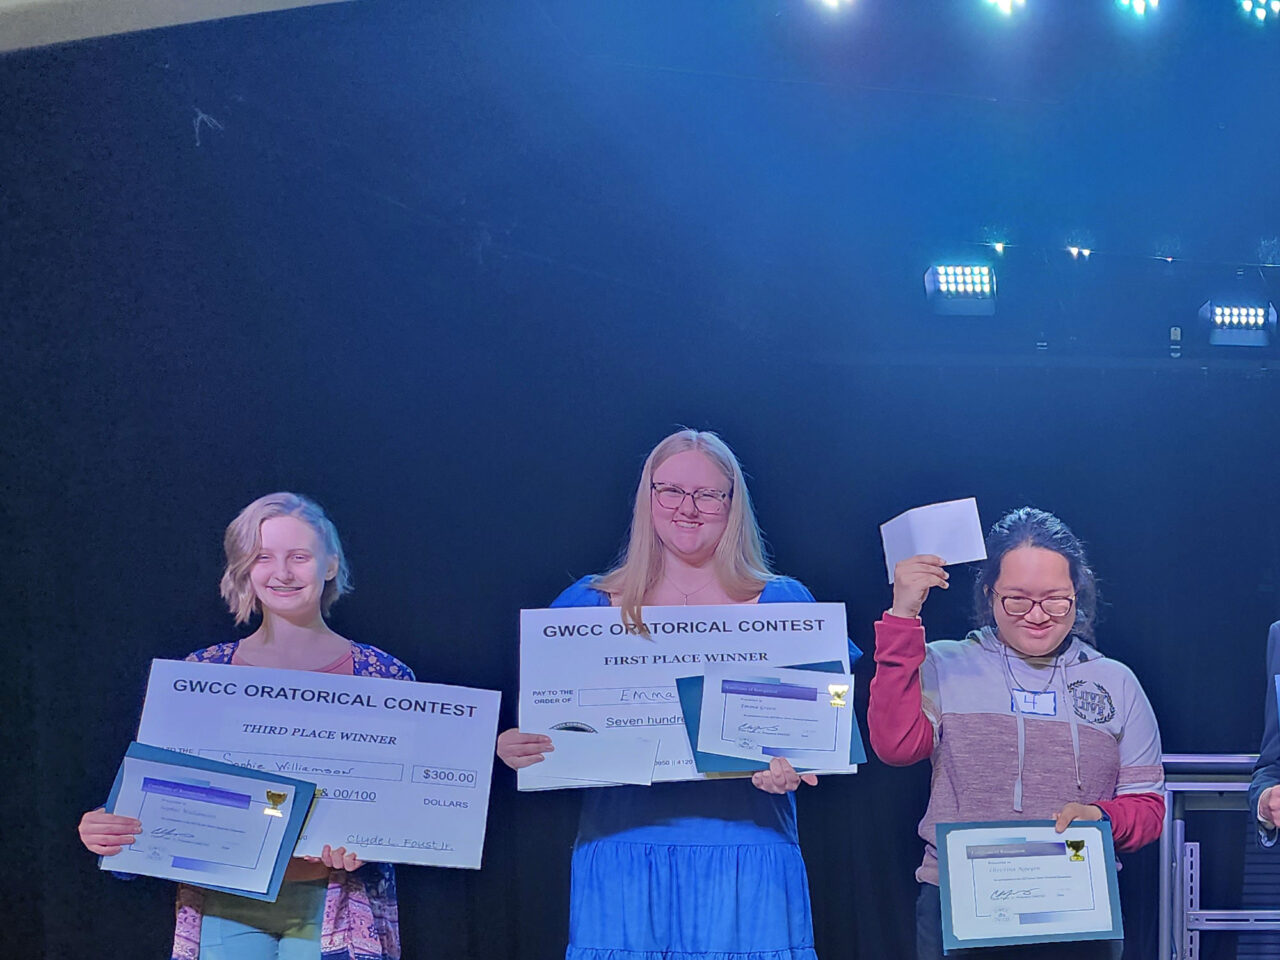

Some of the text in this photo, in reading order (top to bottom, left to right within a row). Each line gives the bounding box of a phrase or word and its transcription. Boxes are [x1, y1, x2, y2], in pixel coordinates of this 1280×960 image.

[543, 624, 602, 637] GWCC
[738, 620, 824, 632] CONTEST
[604, 652, 768, 666] FIRST PLACE WINNER
[173, 679, 478, 718] GWCC ORATORICAL CONTEST
[1024, 694, 1037, 710] 4
[606, 716, 644, 727] Seven
[242, 723, 397, 746] THIRD PLACE WINNER
[423, 769, 474, 783] $300.00
[320, 788, 376, 801] & 00/100
[423, 798, 469, 809] DOLLARS
[346, 834, 384, 848] Clyde
[404, 838, 437, 850] Foust
